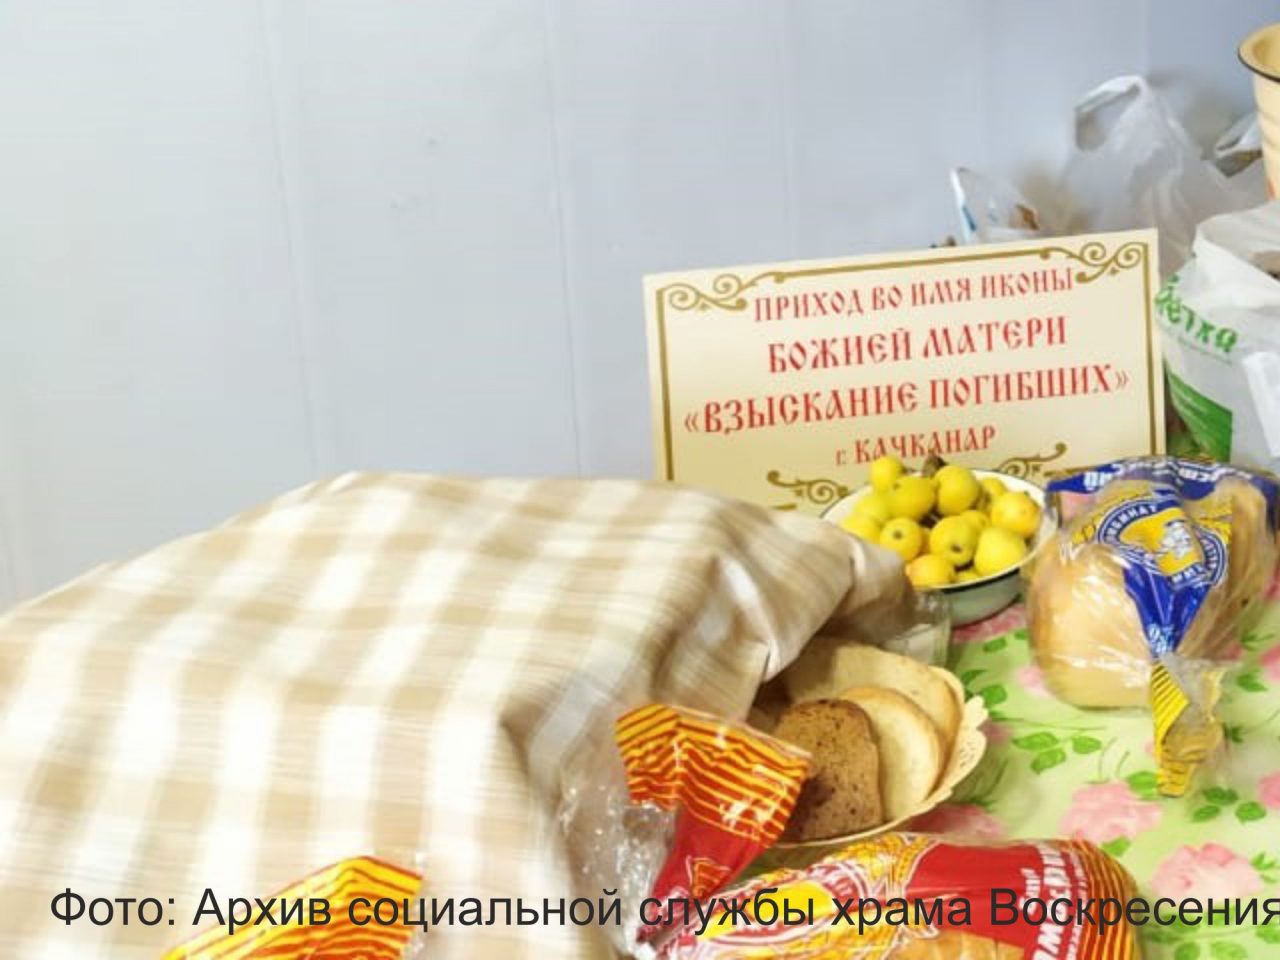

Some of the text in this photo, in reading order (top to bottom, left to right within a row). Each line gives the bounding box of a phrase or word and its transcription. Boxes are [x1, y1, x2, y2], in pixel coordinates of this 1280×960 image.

[755, 268, 1074, 322] ПРИХОД ВО ИМЯ ИКОНЫ
[768, 316, 1067, 375] БОЖИЕЙ МАТЕРИ
[685, 362, 1130, 435] «ВЗЫСКАНИЕ ПОГИБШИХ»
[854, 425, 997, 465] КАЧКАНАР
